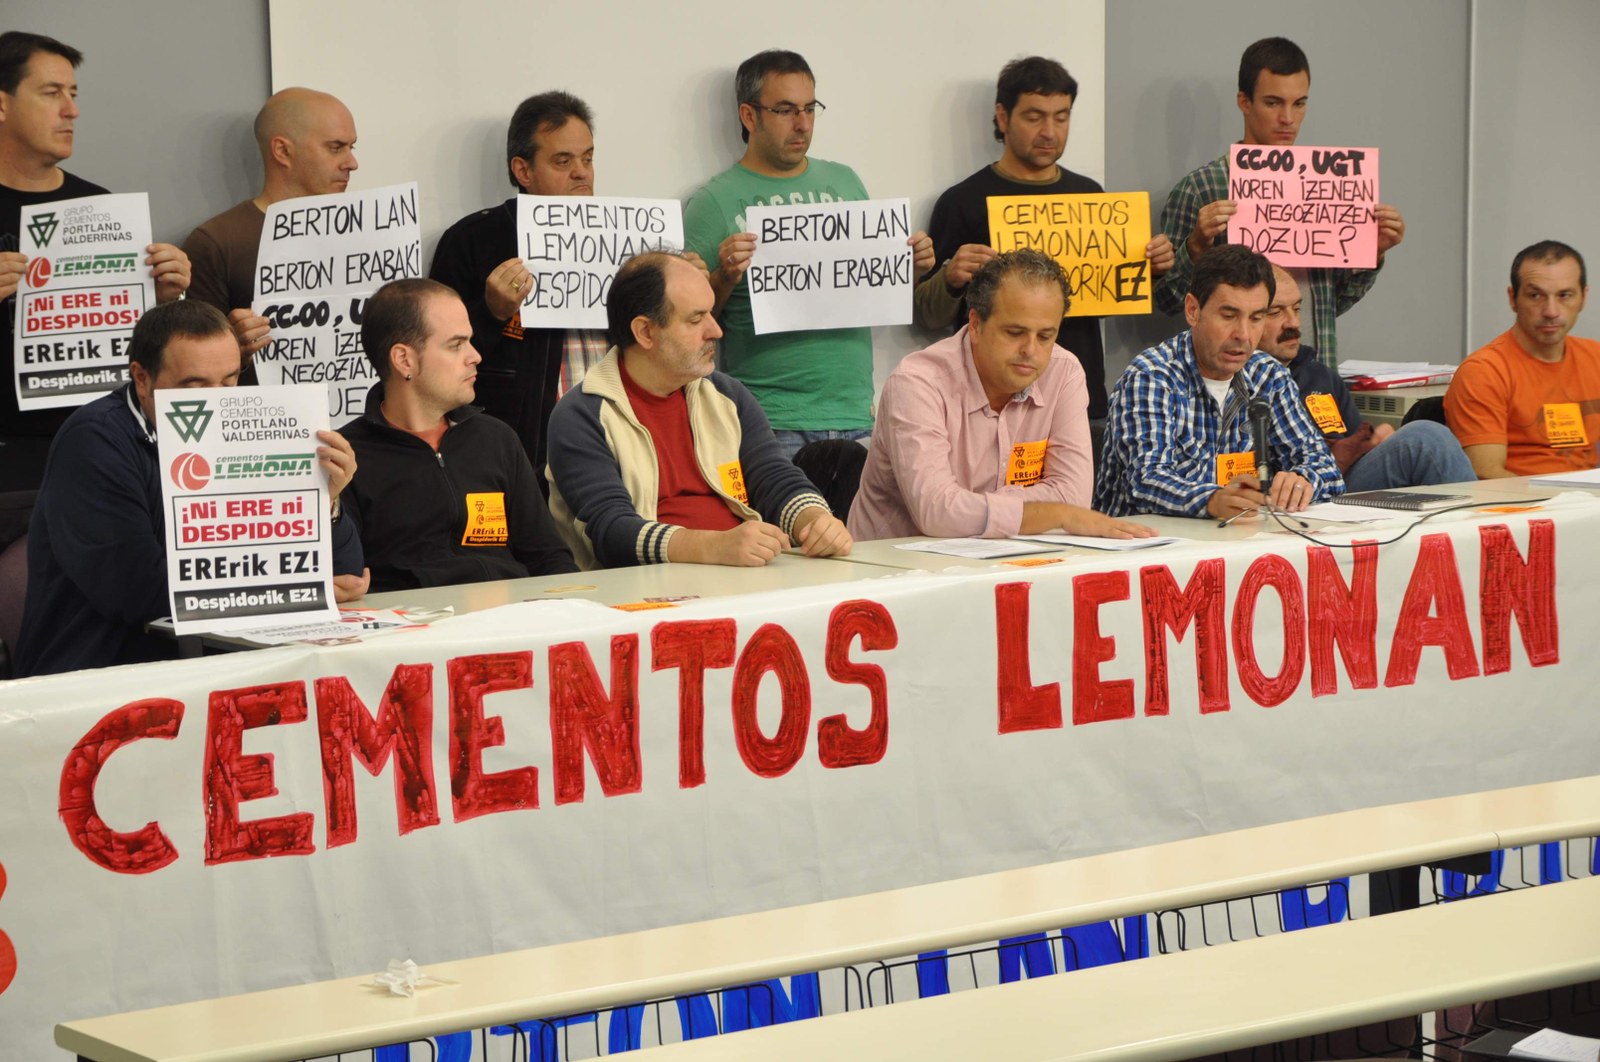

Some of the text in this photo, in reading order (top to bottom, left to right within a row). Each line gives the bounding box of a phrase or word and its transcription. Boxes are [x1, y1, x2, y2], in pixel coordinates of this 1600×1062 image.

[1312, 150, 1365, 177] UGT
[1231, 178, 1284, 200] NOREN
[63, 213, 111, 226] CEMENTOS
[64, 204, 94, 217] GRUPO
[273, 188, 417, 241] BERTON LAN
[532, 203, 666, 234] CEMENTOS
[1003, 200, 1129, 226] CEMENTOS
[63, 222, 121, 235] PORTLAND
[761, 203, 909, 244] BERTON LAN
[62, 232, 133, 246] VALDERRIVAS
[53, 258, 137, 278] LEMONA
[56, 254, 93, 264] cementos
[260, 256, 334, 296] BERTON
[751, 261, 822, 294] BERTON
[61, 292, 102, 309] ERE
[109, 290, 129, 306] ni
[26, 309, 141, 333] DESPIDOS!
[24, 340, 102, 364] ERErik
[28, 370, 117, 390] Despidorik
[219, 396, 263, 408] GRUPO
[220, 406, 286, 419] CEMENTOS
[221, 417, 298, 431] PORTLAND
[221, 428, 310, 443] VALDERRIVAS
[214, 459, 313, 480] LEMONA
[216, 454, 264, 463] cementos
[182, 496, 303, 524] ¡Ni ERE ni
[182, 519, 313, 544] DESPIDOS!
[179, 550, 319, 582] ERErik EZ!
[184, 587, 318, 612] Despidorik EZ!
[58, 518, 1560, 875] CEMENTOS LEMONAN
